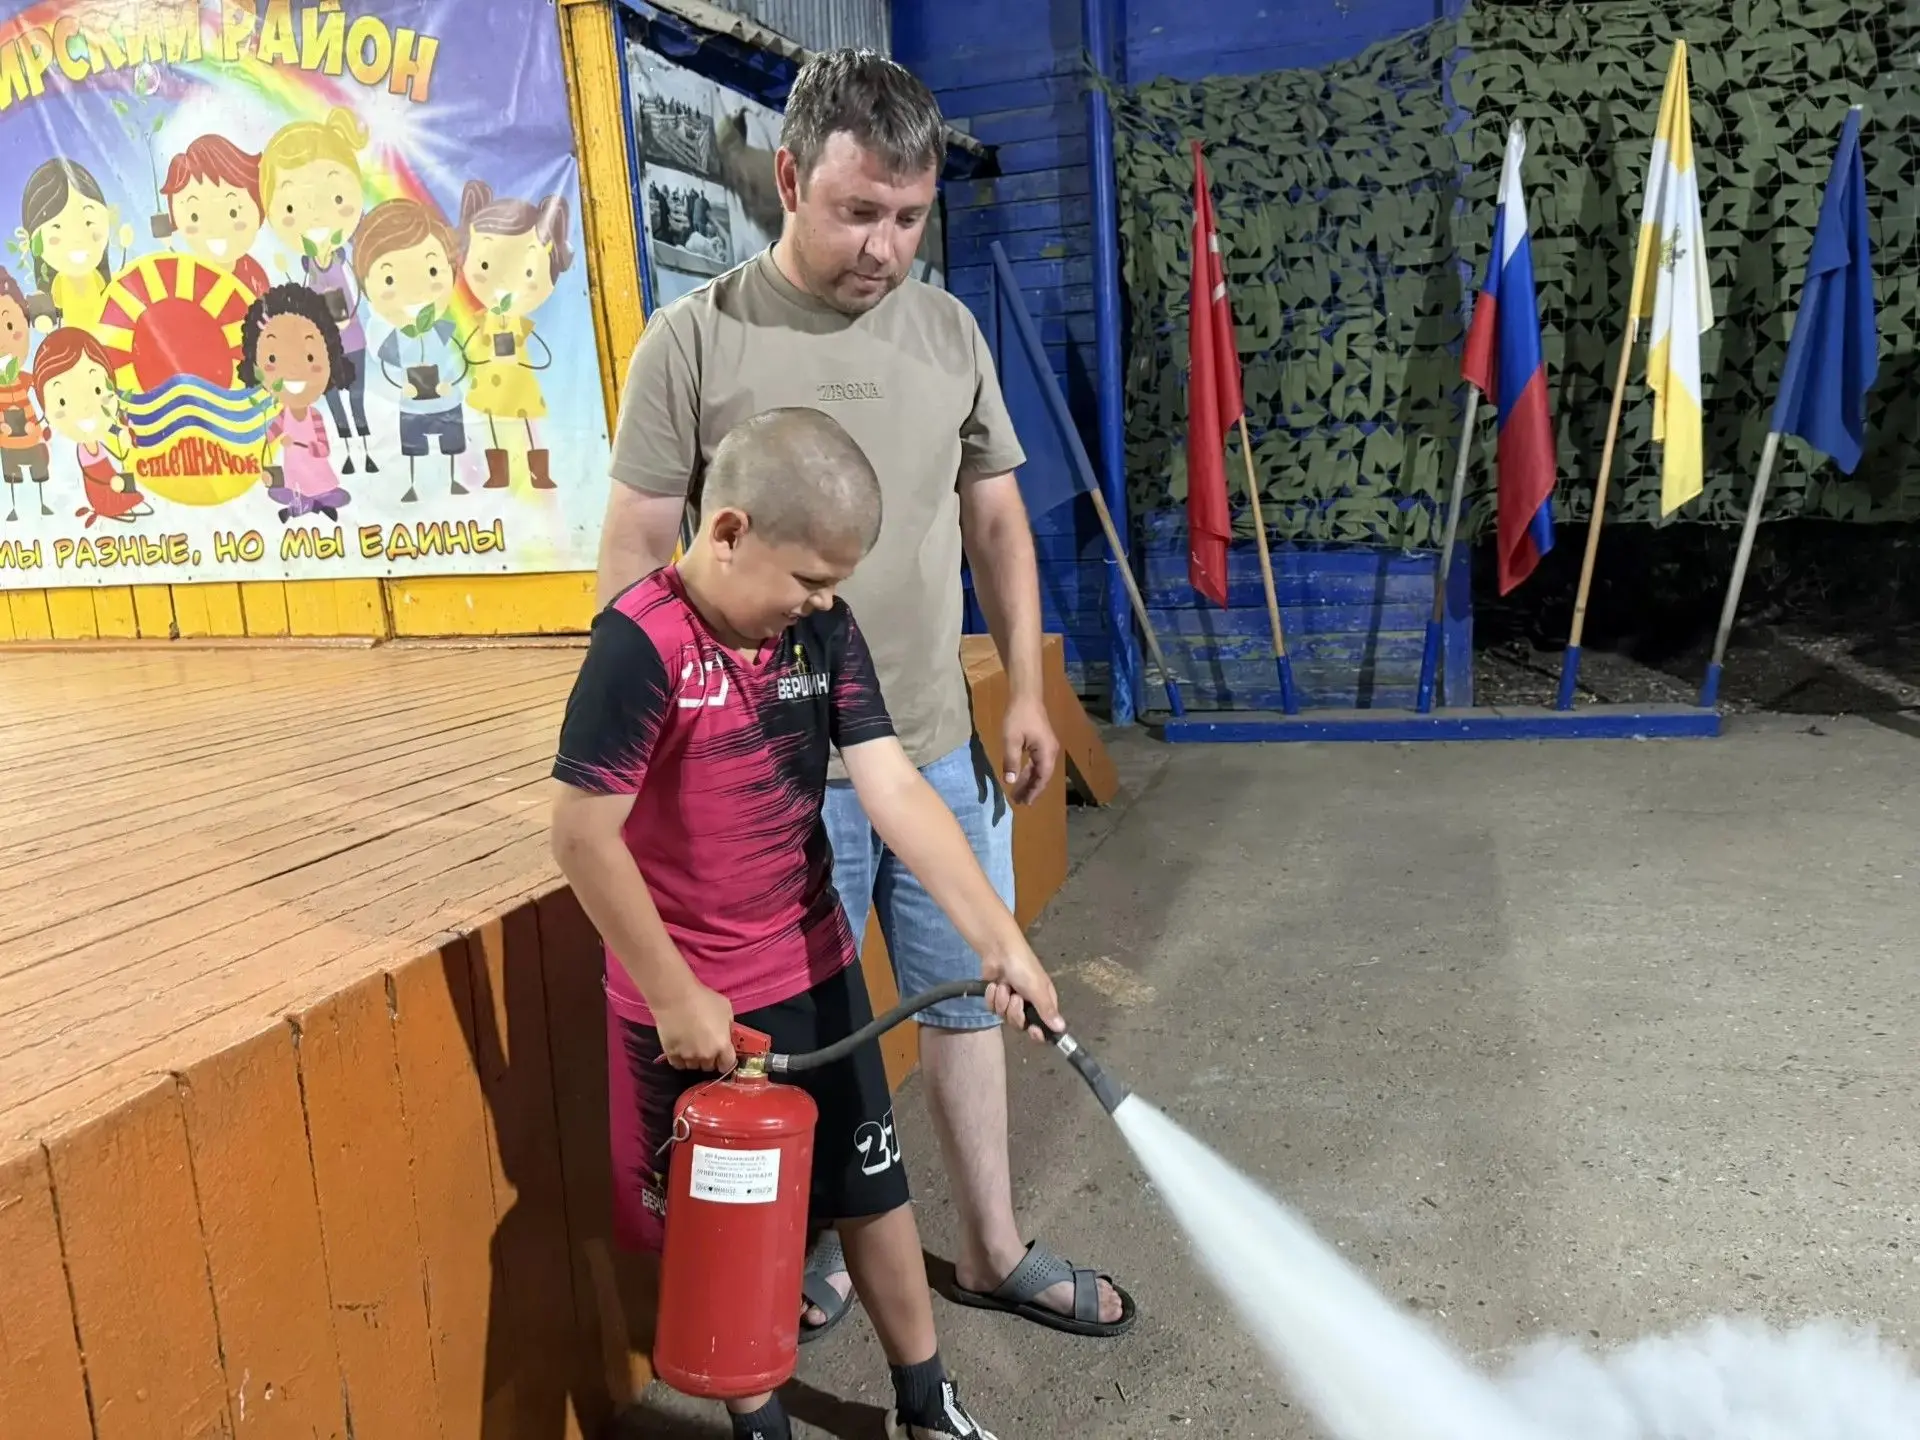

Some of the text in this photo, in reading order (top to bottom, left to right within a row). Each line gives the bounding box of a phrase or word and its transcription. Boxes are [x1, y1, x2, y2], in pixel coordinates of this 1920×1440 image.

[221, 0, 439, 103] РАЙОН
[53, 533, 201, 568] РАЗНЫЕ,
[213, 529, 265, 563] НО
[280, 526, 345, 561] МЫ
[358, 518, 504, 561] ЕДИНЫ
[777, 672, 830, 700] ВЕРШИН
